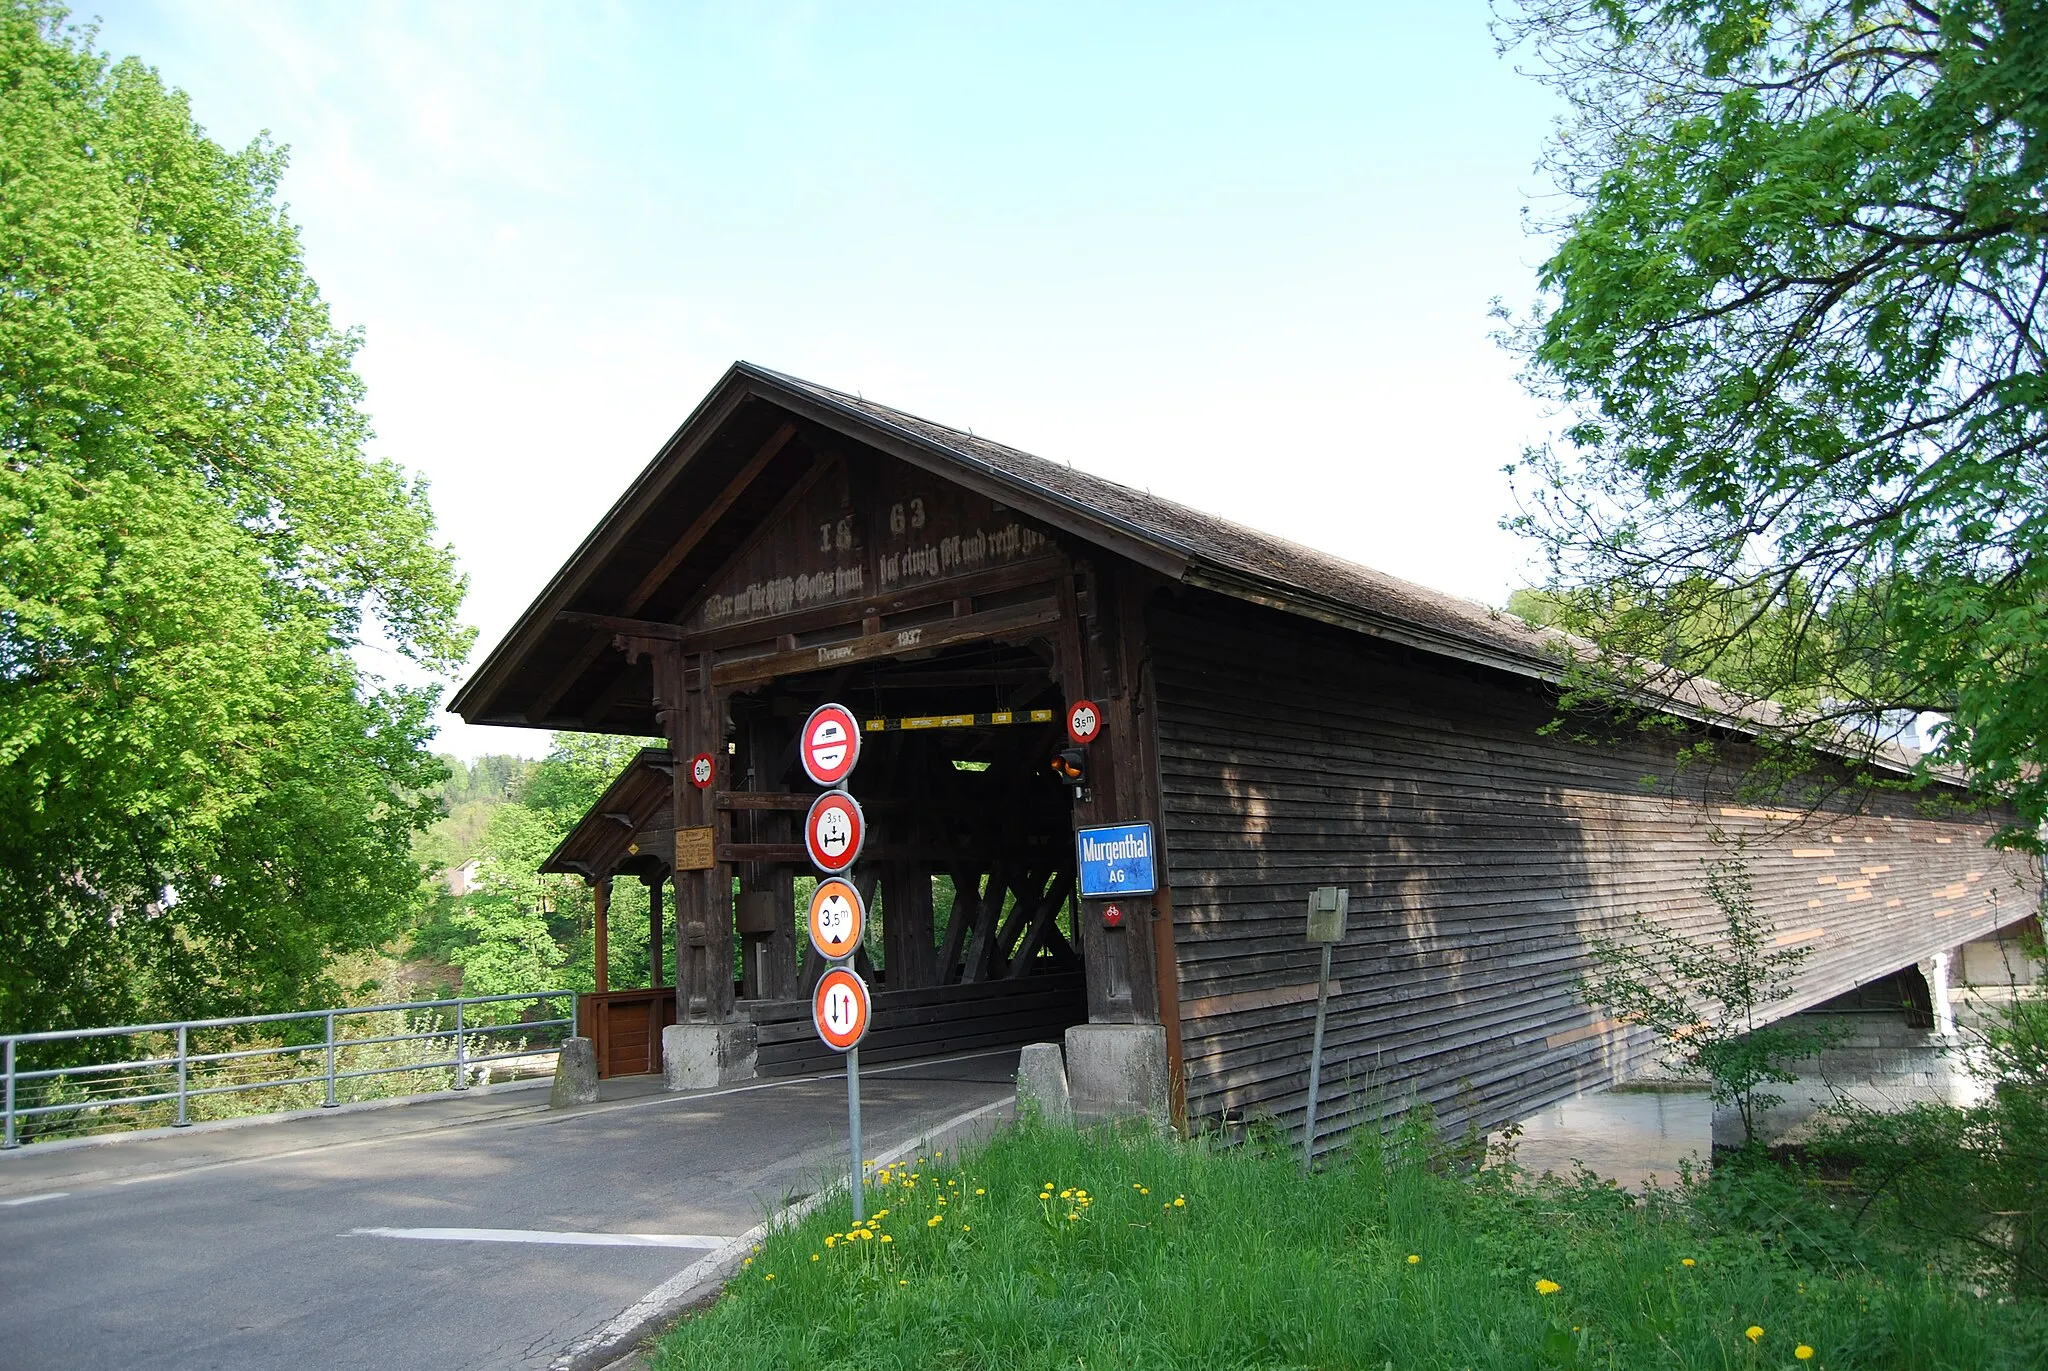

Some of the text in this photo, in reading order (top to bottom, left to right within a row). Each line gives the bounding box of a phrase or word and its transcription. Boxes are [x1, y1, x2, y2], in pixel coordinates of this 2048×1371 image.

[890, 497, 925, 534] 63
[1082, 832, 1148, 867] Murgenthal
[1109, 869, 1125, 883] AG
